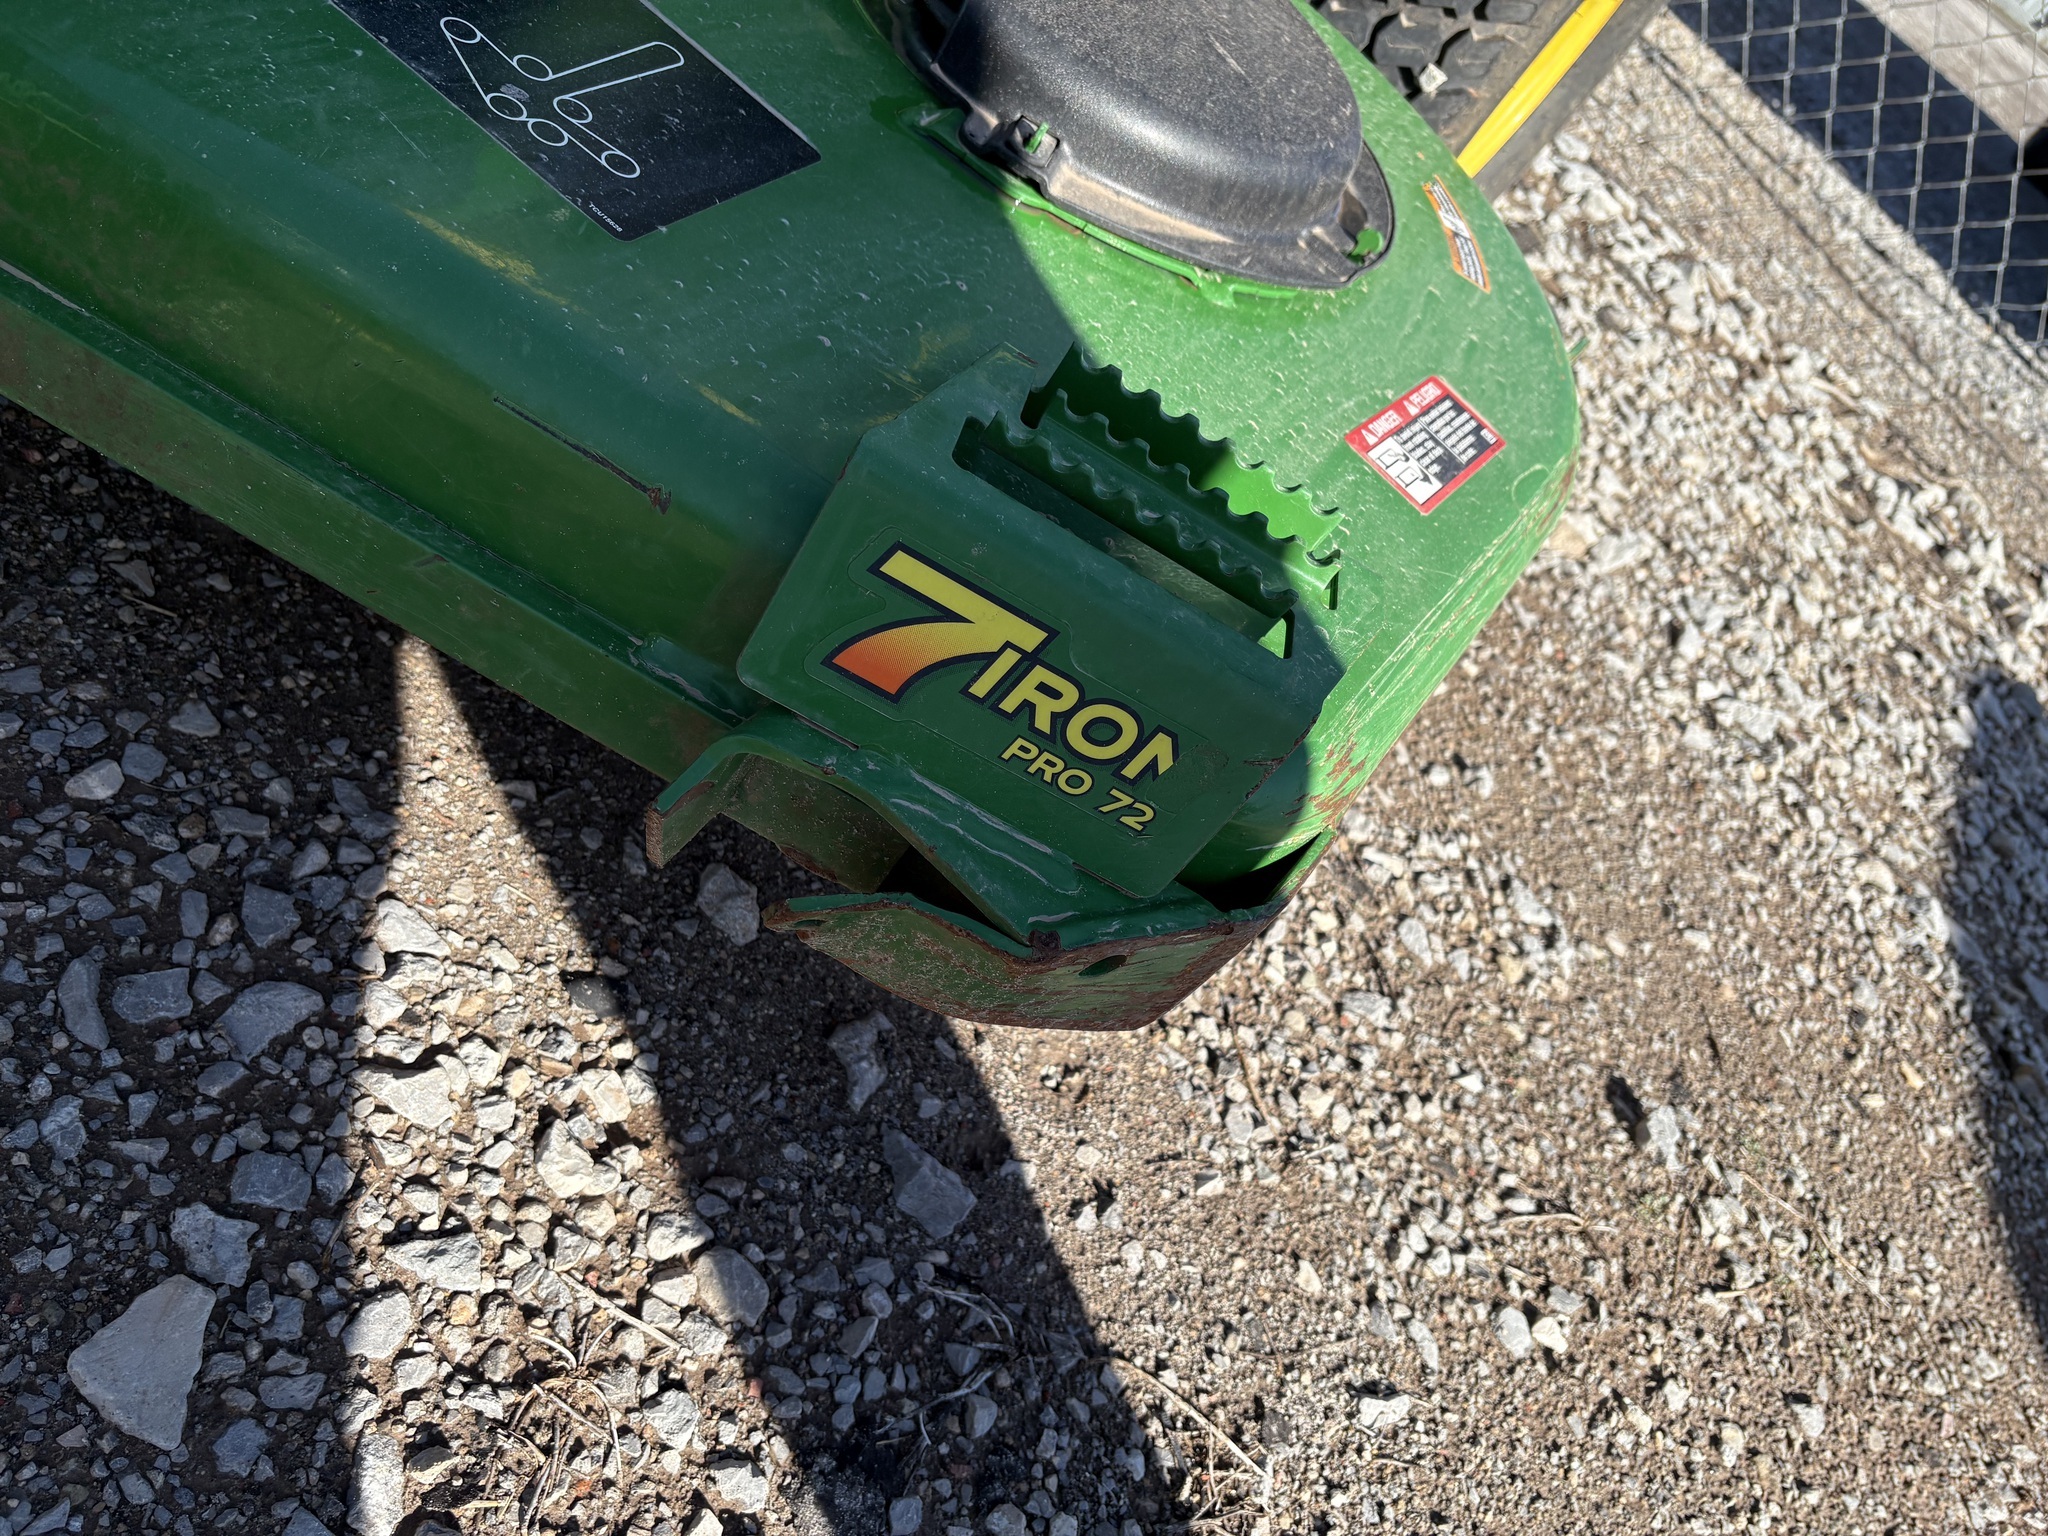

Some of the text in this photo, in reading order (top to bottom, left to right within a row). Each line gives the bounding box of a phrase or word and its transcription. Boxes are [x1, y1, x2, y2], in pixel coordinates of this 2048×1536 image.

[1409, 382, 1443, 408] PELIGRO
[1368, 410, 1403, 438] DANGER
[1000, 736, 1156, 833] PRO 72
